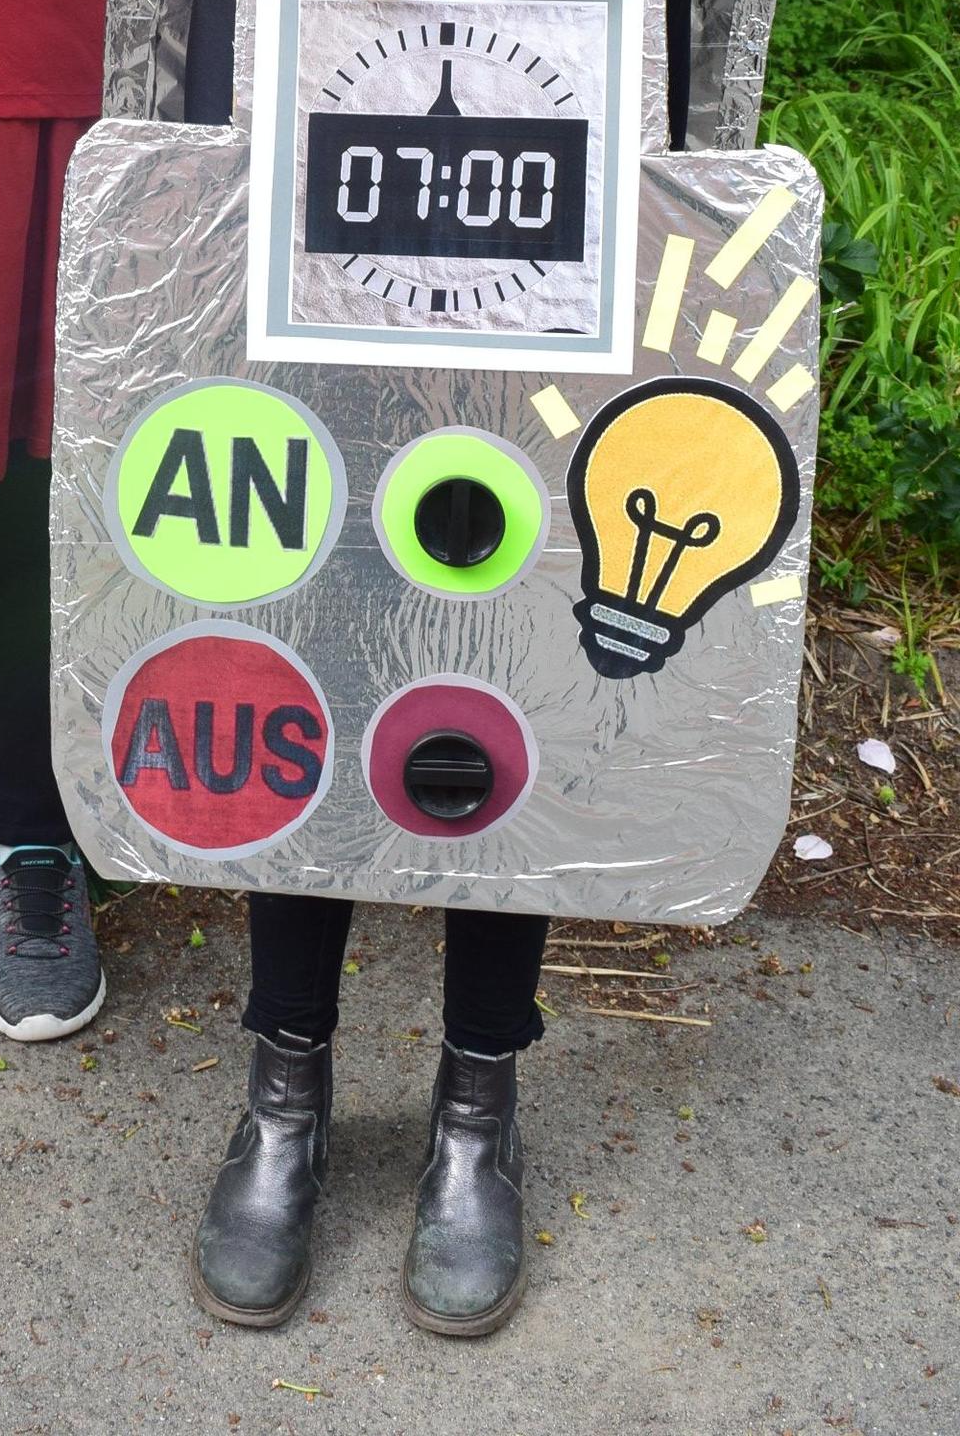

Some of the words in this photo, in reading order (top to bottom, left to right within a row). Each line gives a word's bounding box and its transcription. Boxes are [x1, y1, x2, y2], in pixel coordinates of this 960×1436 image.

[336, 146, 556, 229] 07:00
[131, 428, 309, 551] AN
[119, 698, 323, 800] AUS
